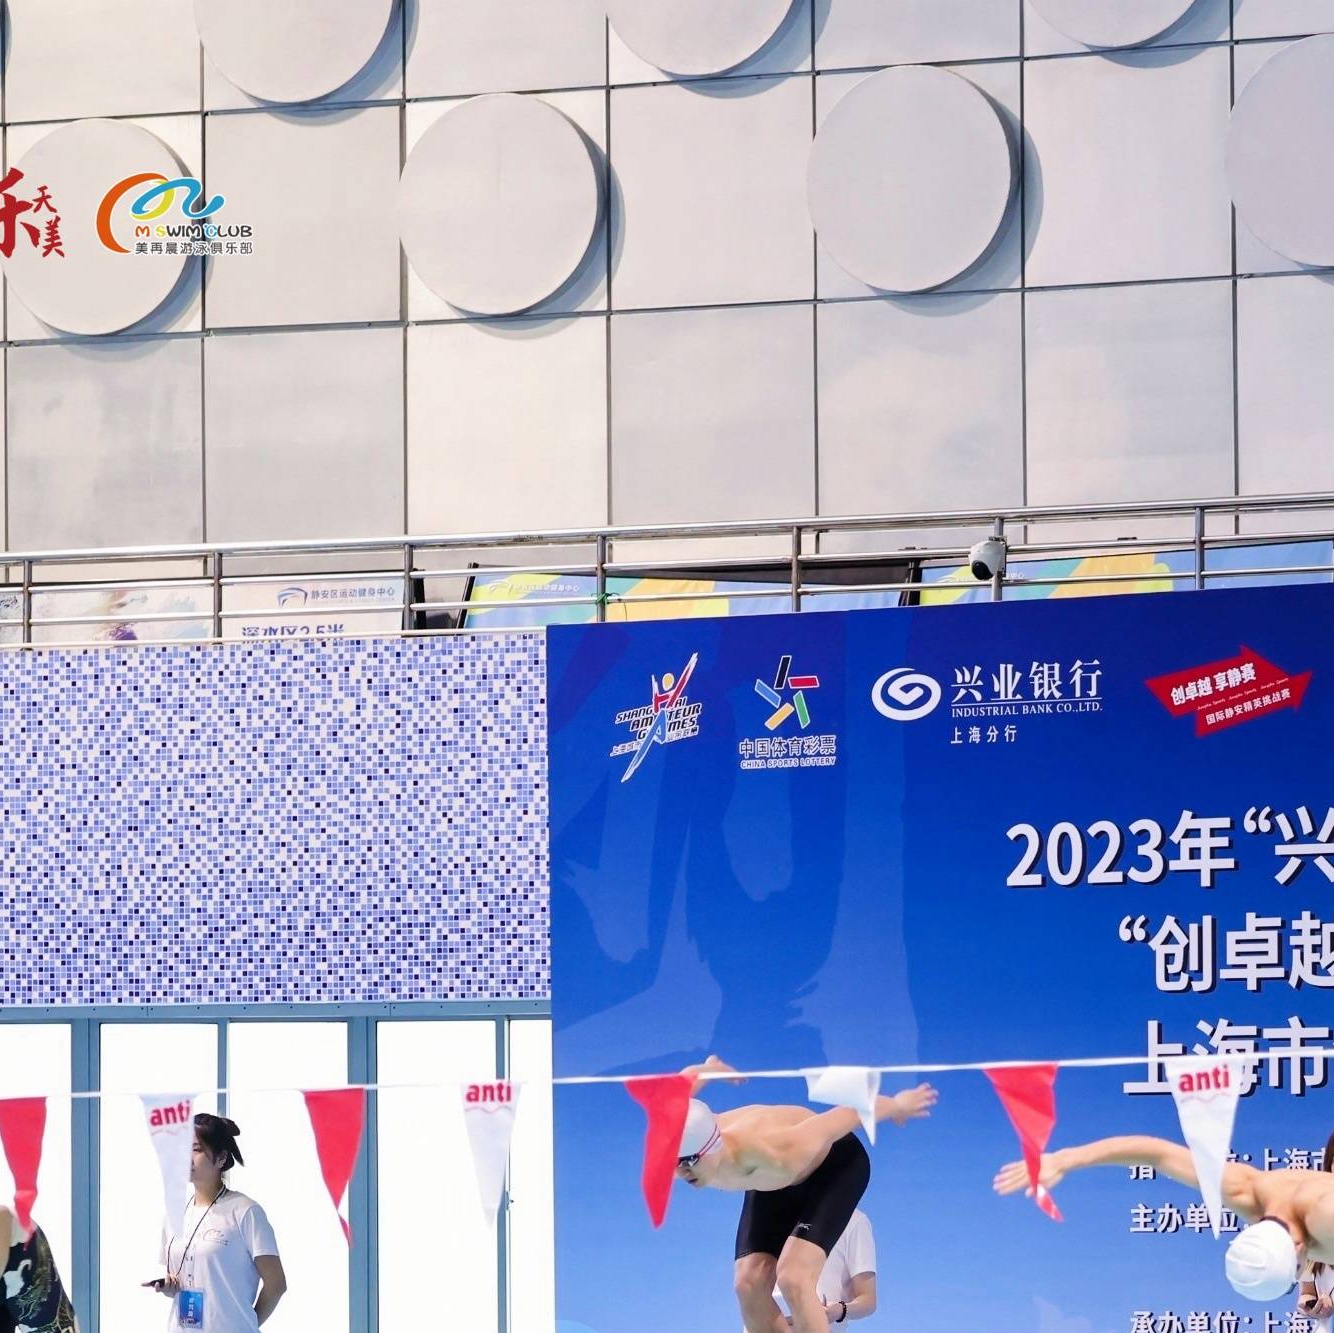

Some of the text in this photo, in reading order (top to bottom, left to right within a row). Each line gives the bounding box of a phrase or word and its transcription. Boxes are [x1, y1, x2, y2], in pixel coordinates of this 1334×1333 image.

[310, 587, 395, 600] 静安区运动健身中心
[951, 659, 1103, 703] 兴业银行
[1171, 677, 1213, 706] 创卓越
[1214, 662, 1257, 692] 享静赛
[951, 705, 1019, 718] INDUSTRIAL
[1022, 704, 1053, 715] BANK
[1205, 688, 1291, 726] 国际静安精英挑战赛
[951, 725, 1017, 744] 上海分行
[740, 735, 836, 758] 中国体育彩票
[741, 757, 836, 769] CHINA SPORTS LOTTERY
[1178, 1065, 1231, 1093] anti
[465, 1081, 513, 1104] anti
[150, 1100, 191, 1127] anti
